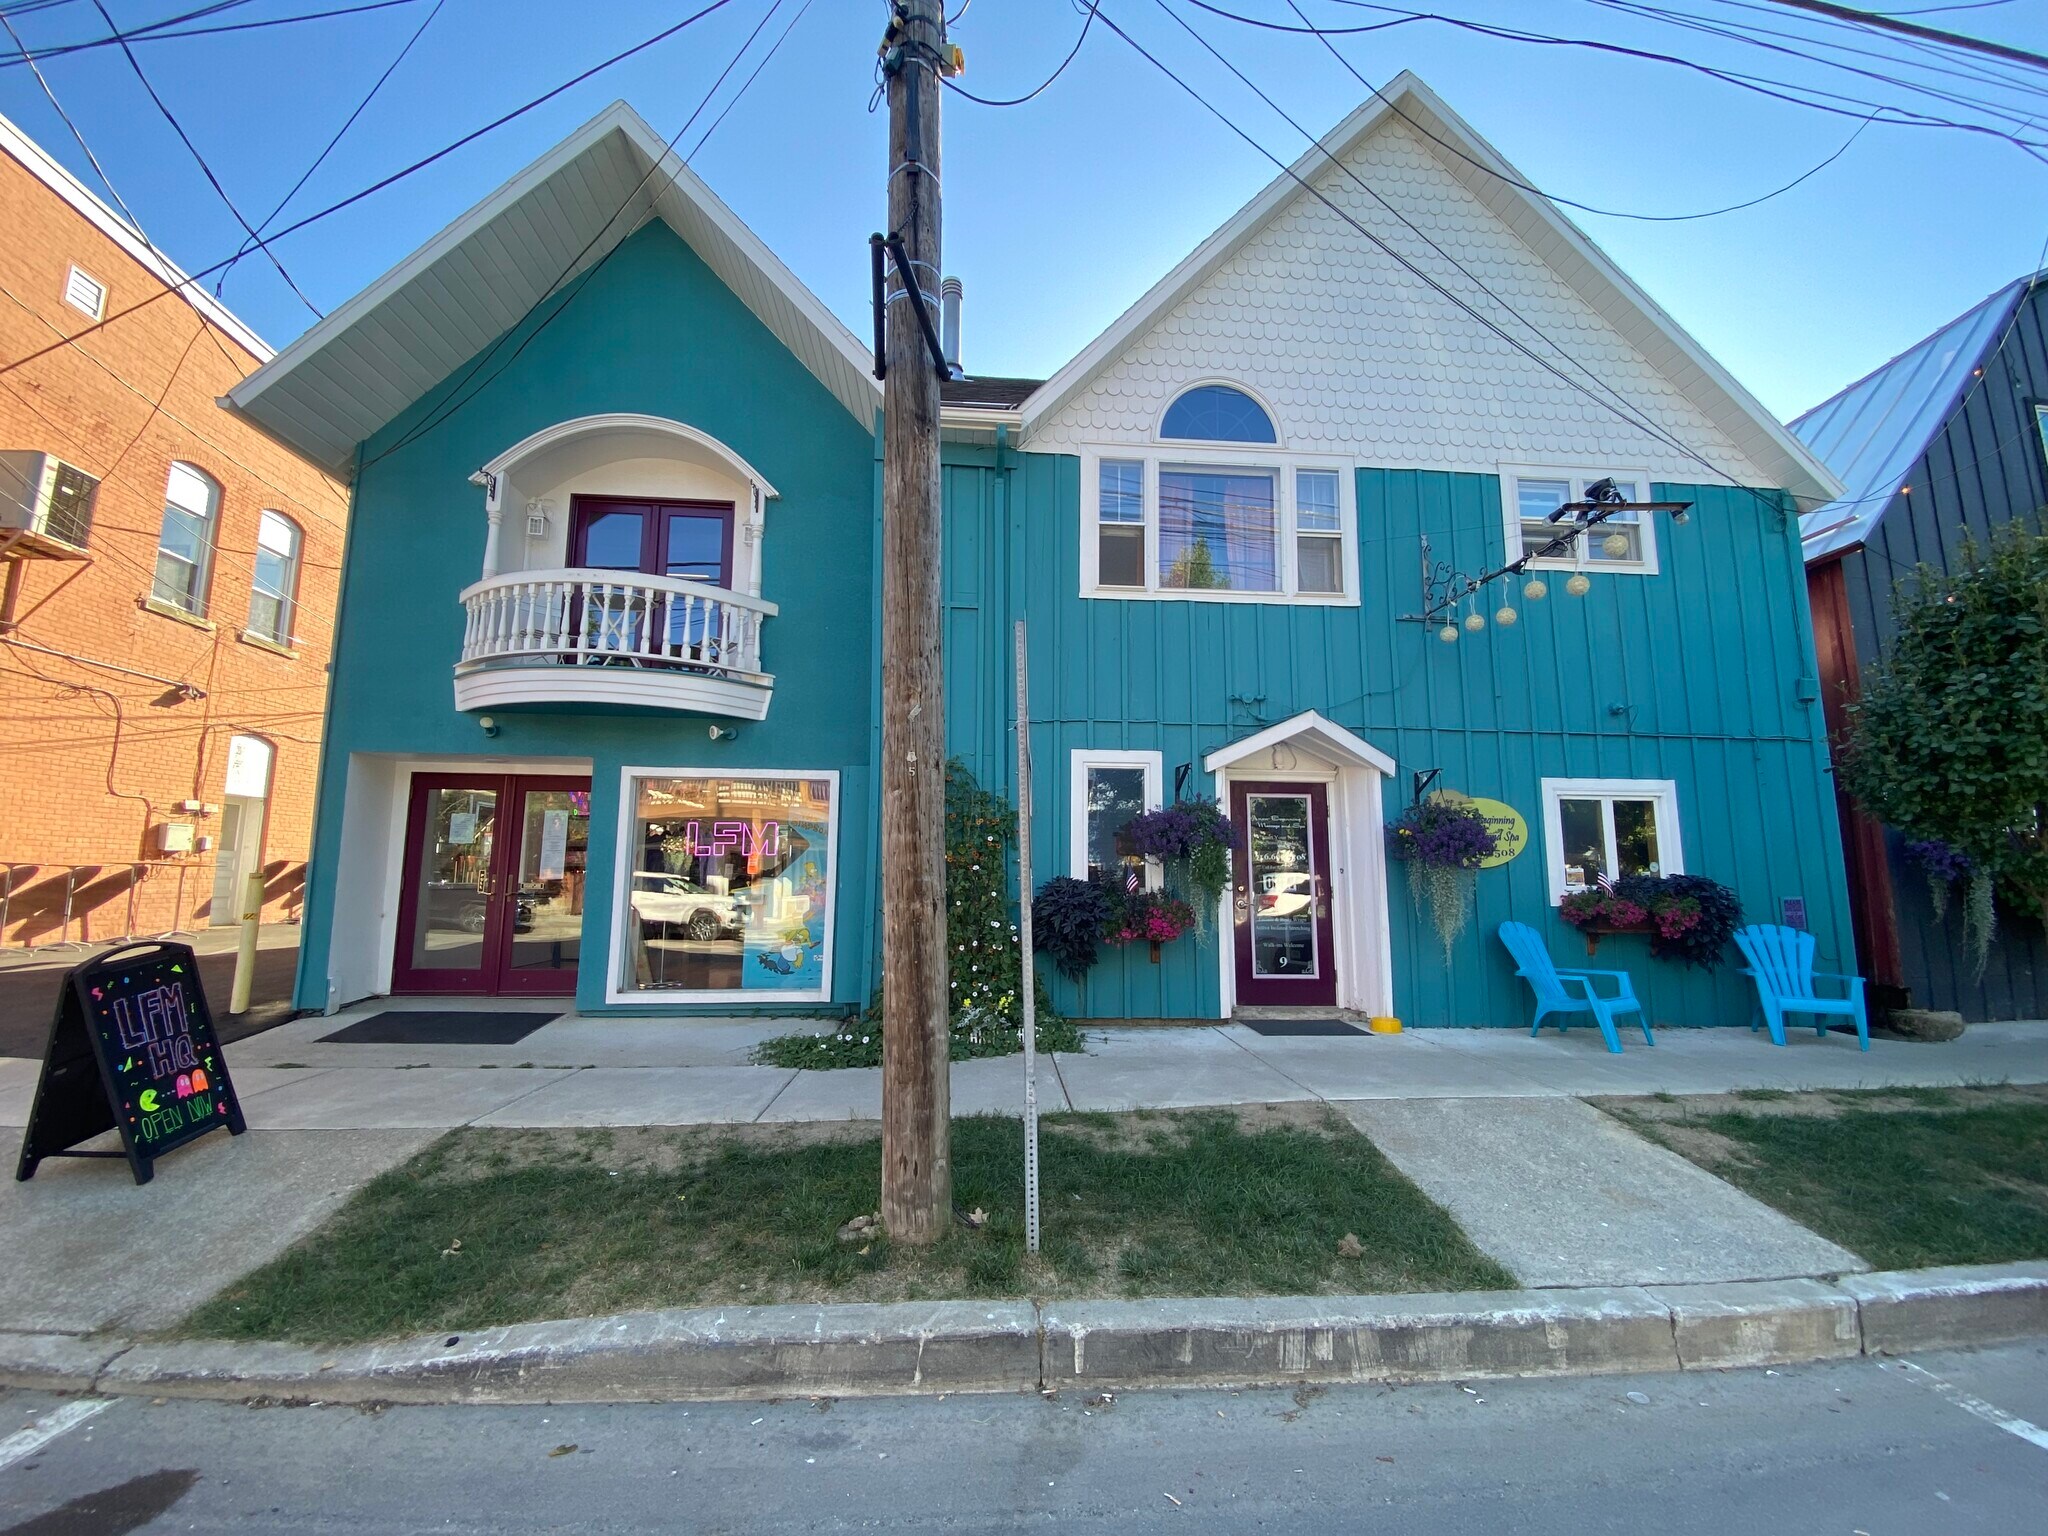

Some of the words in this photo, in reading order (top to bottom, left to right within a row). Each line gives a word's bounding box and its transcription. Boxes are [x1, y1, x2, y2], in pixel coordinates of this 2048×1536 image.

[686, 821, 779, 858] LFM
[1504, 831, 1519, 847] Spa
[1279, 956, 1288, 968] 9
[113, 982, 189, 1050] LFM
[148, 1034, 199, 1080] HQ
[141, 1104, 184, 1143] OPEN
[186, 1092, 213, 1123] NOW
